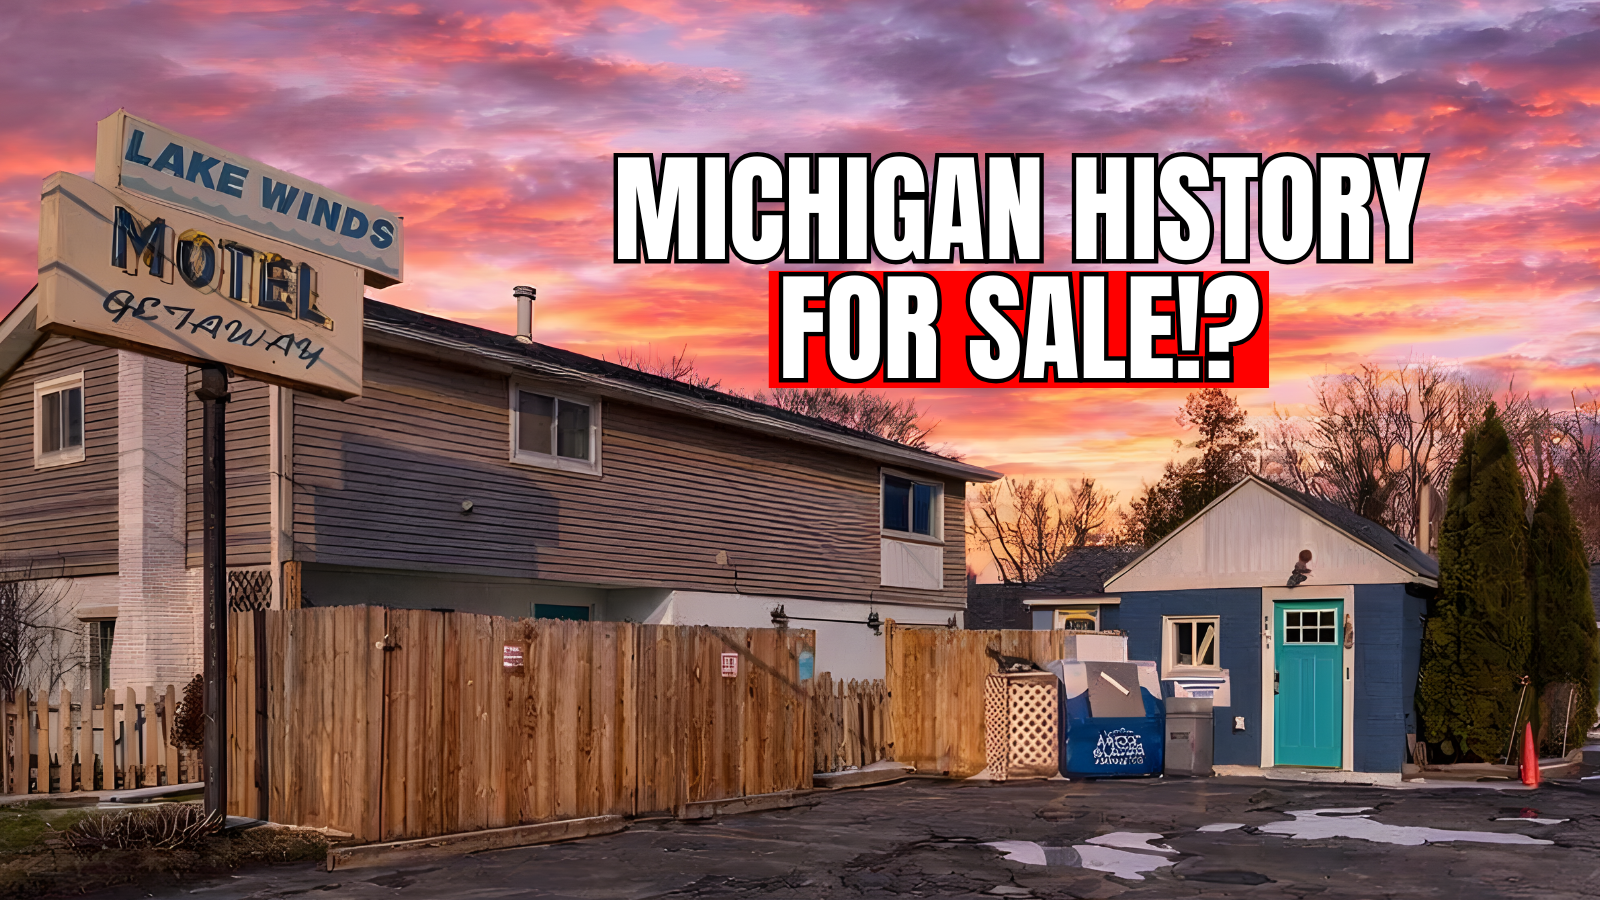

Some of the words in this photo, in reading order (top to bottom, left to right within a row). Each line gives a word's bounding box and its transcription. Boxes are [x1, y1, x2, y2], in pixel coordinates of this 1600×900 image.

[124, 129, 249, 198] LAKE
[262, 176, 394, 249] WINDS
[111, 206, 333, 331] MOTEL
[103, 290, 324, 369] GETAWAY
